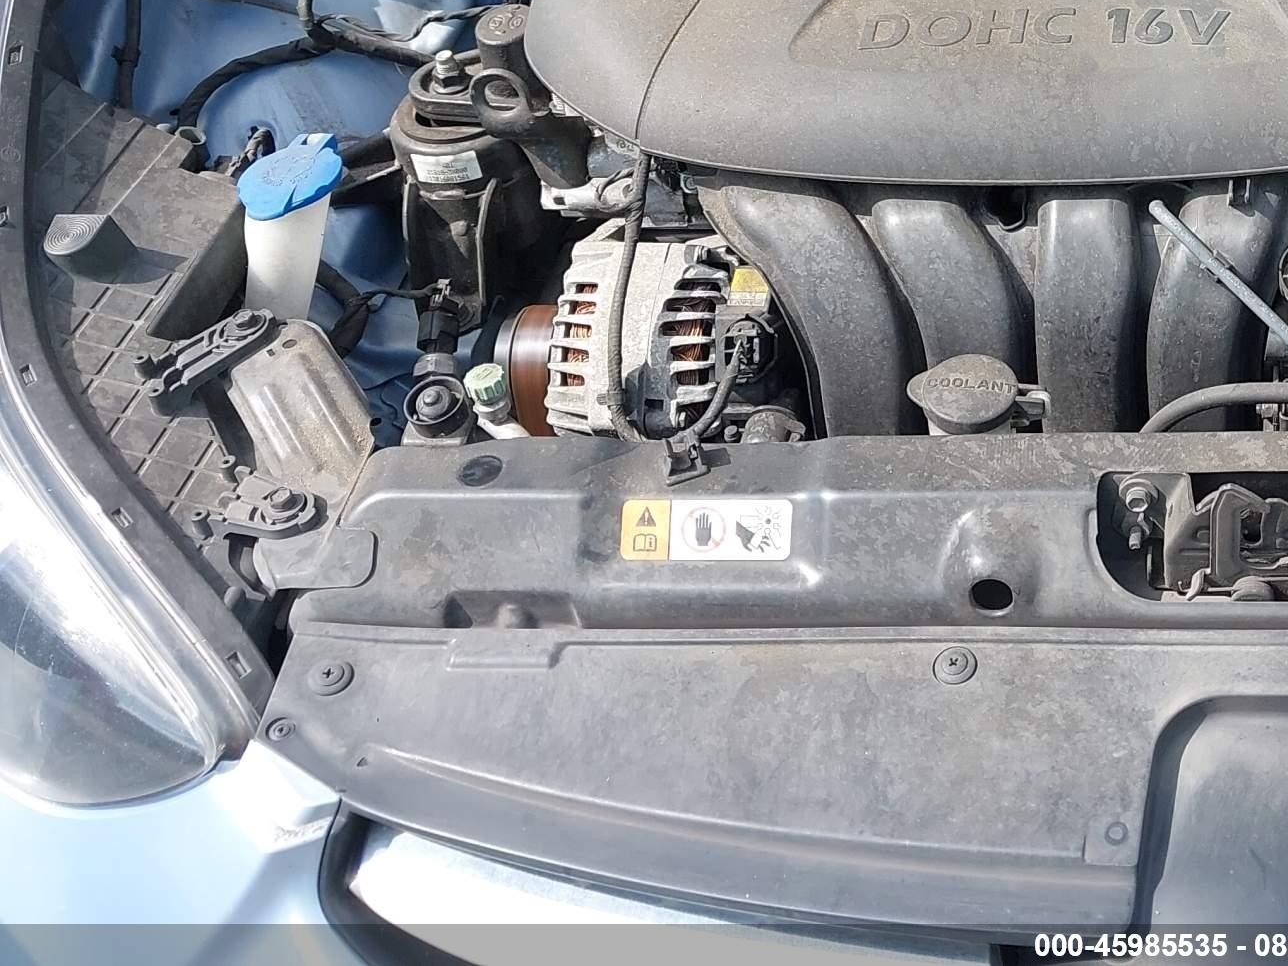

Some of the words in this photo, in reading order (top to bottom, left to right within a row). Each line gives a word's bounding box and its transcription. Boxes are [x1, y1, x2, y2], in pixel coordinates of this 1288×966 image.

[857, 7, 1077, 51] DOHC
[1106, 7, 1232, 46] 16V
[927, 376, 1017, 395] COOLANT
